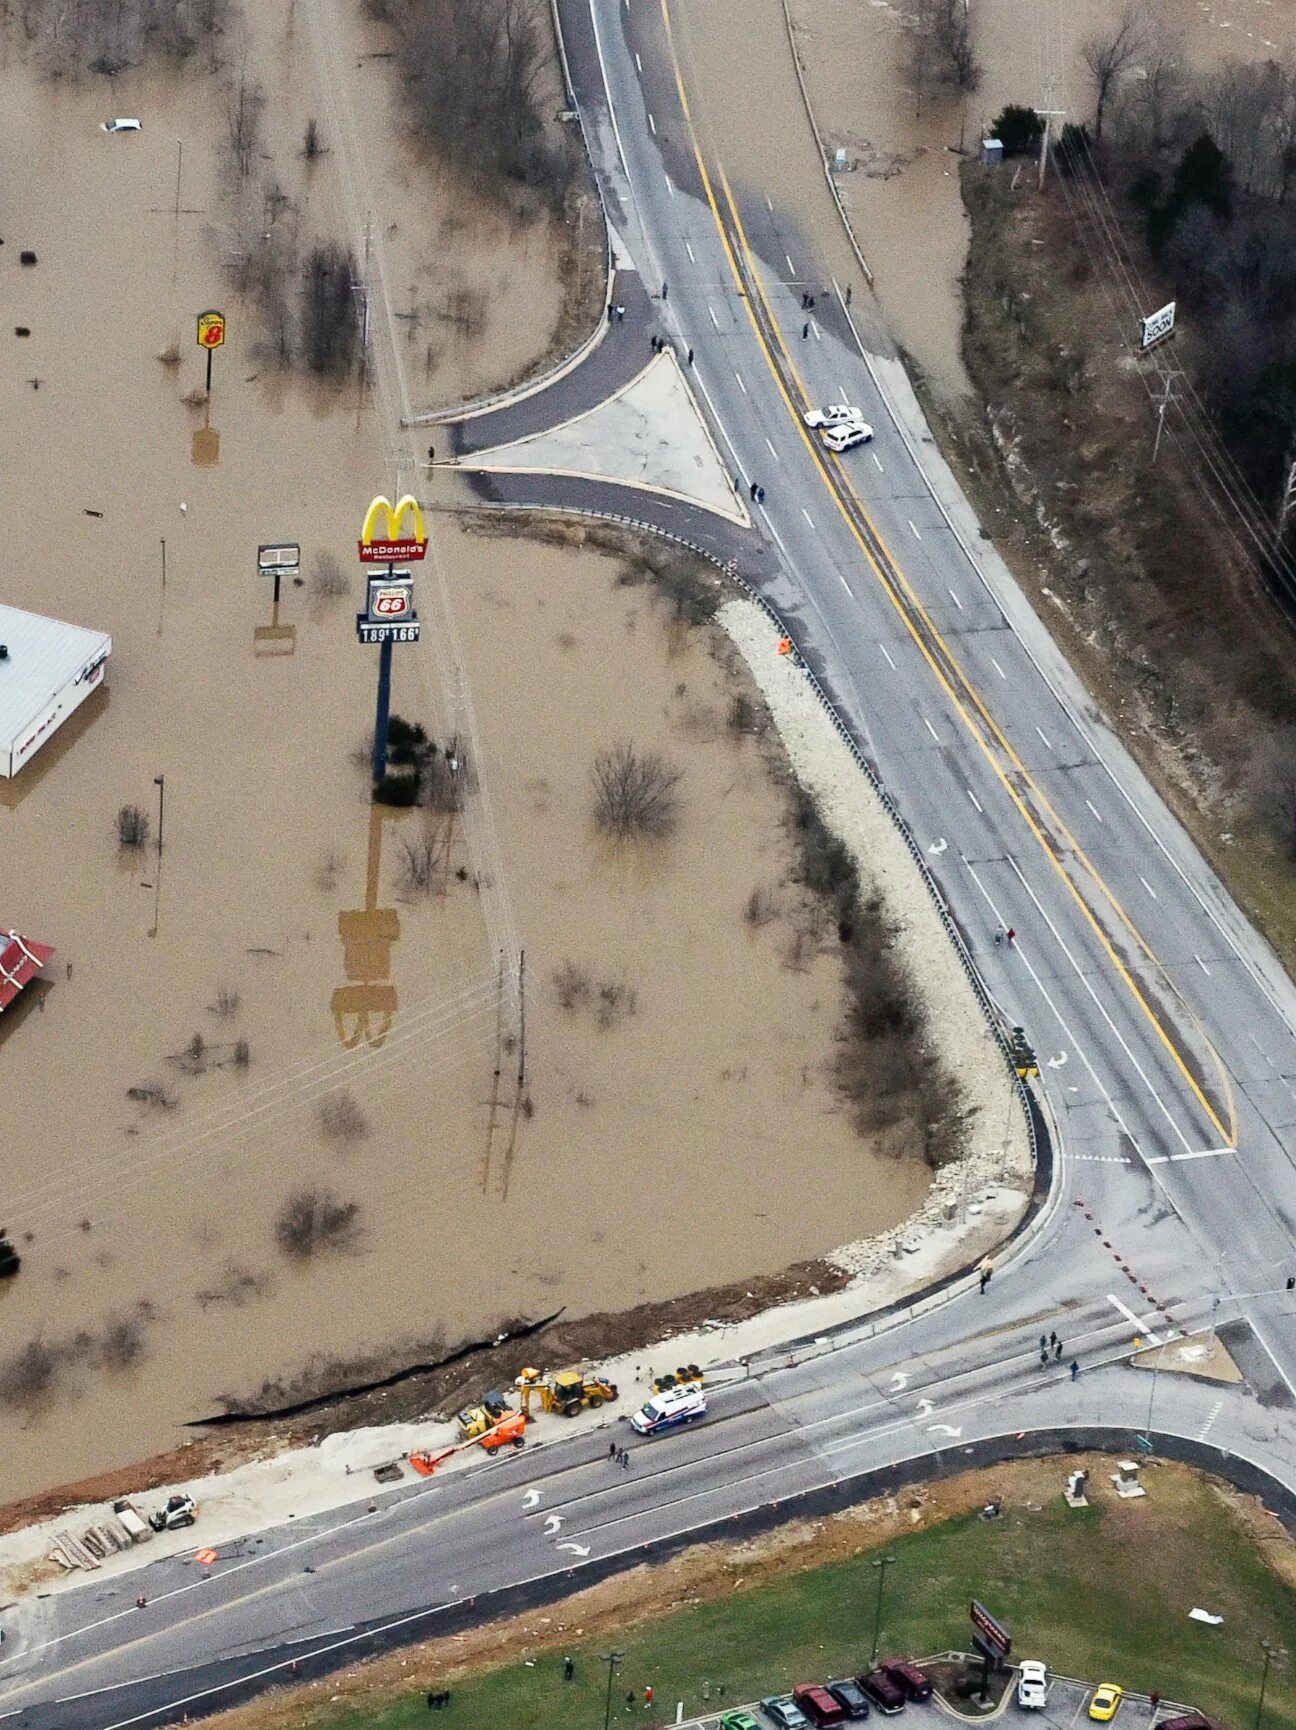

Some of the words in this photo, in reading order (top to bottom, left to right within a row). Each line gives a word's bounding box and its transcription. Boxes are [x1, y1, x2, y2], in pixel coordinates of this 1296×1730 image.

[204, 325, 222, 345] 8
[362, 545, 424, 555] McDonald's
[379, 598, 403, 612] 66
